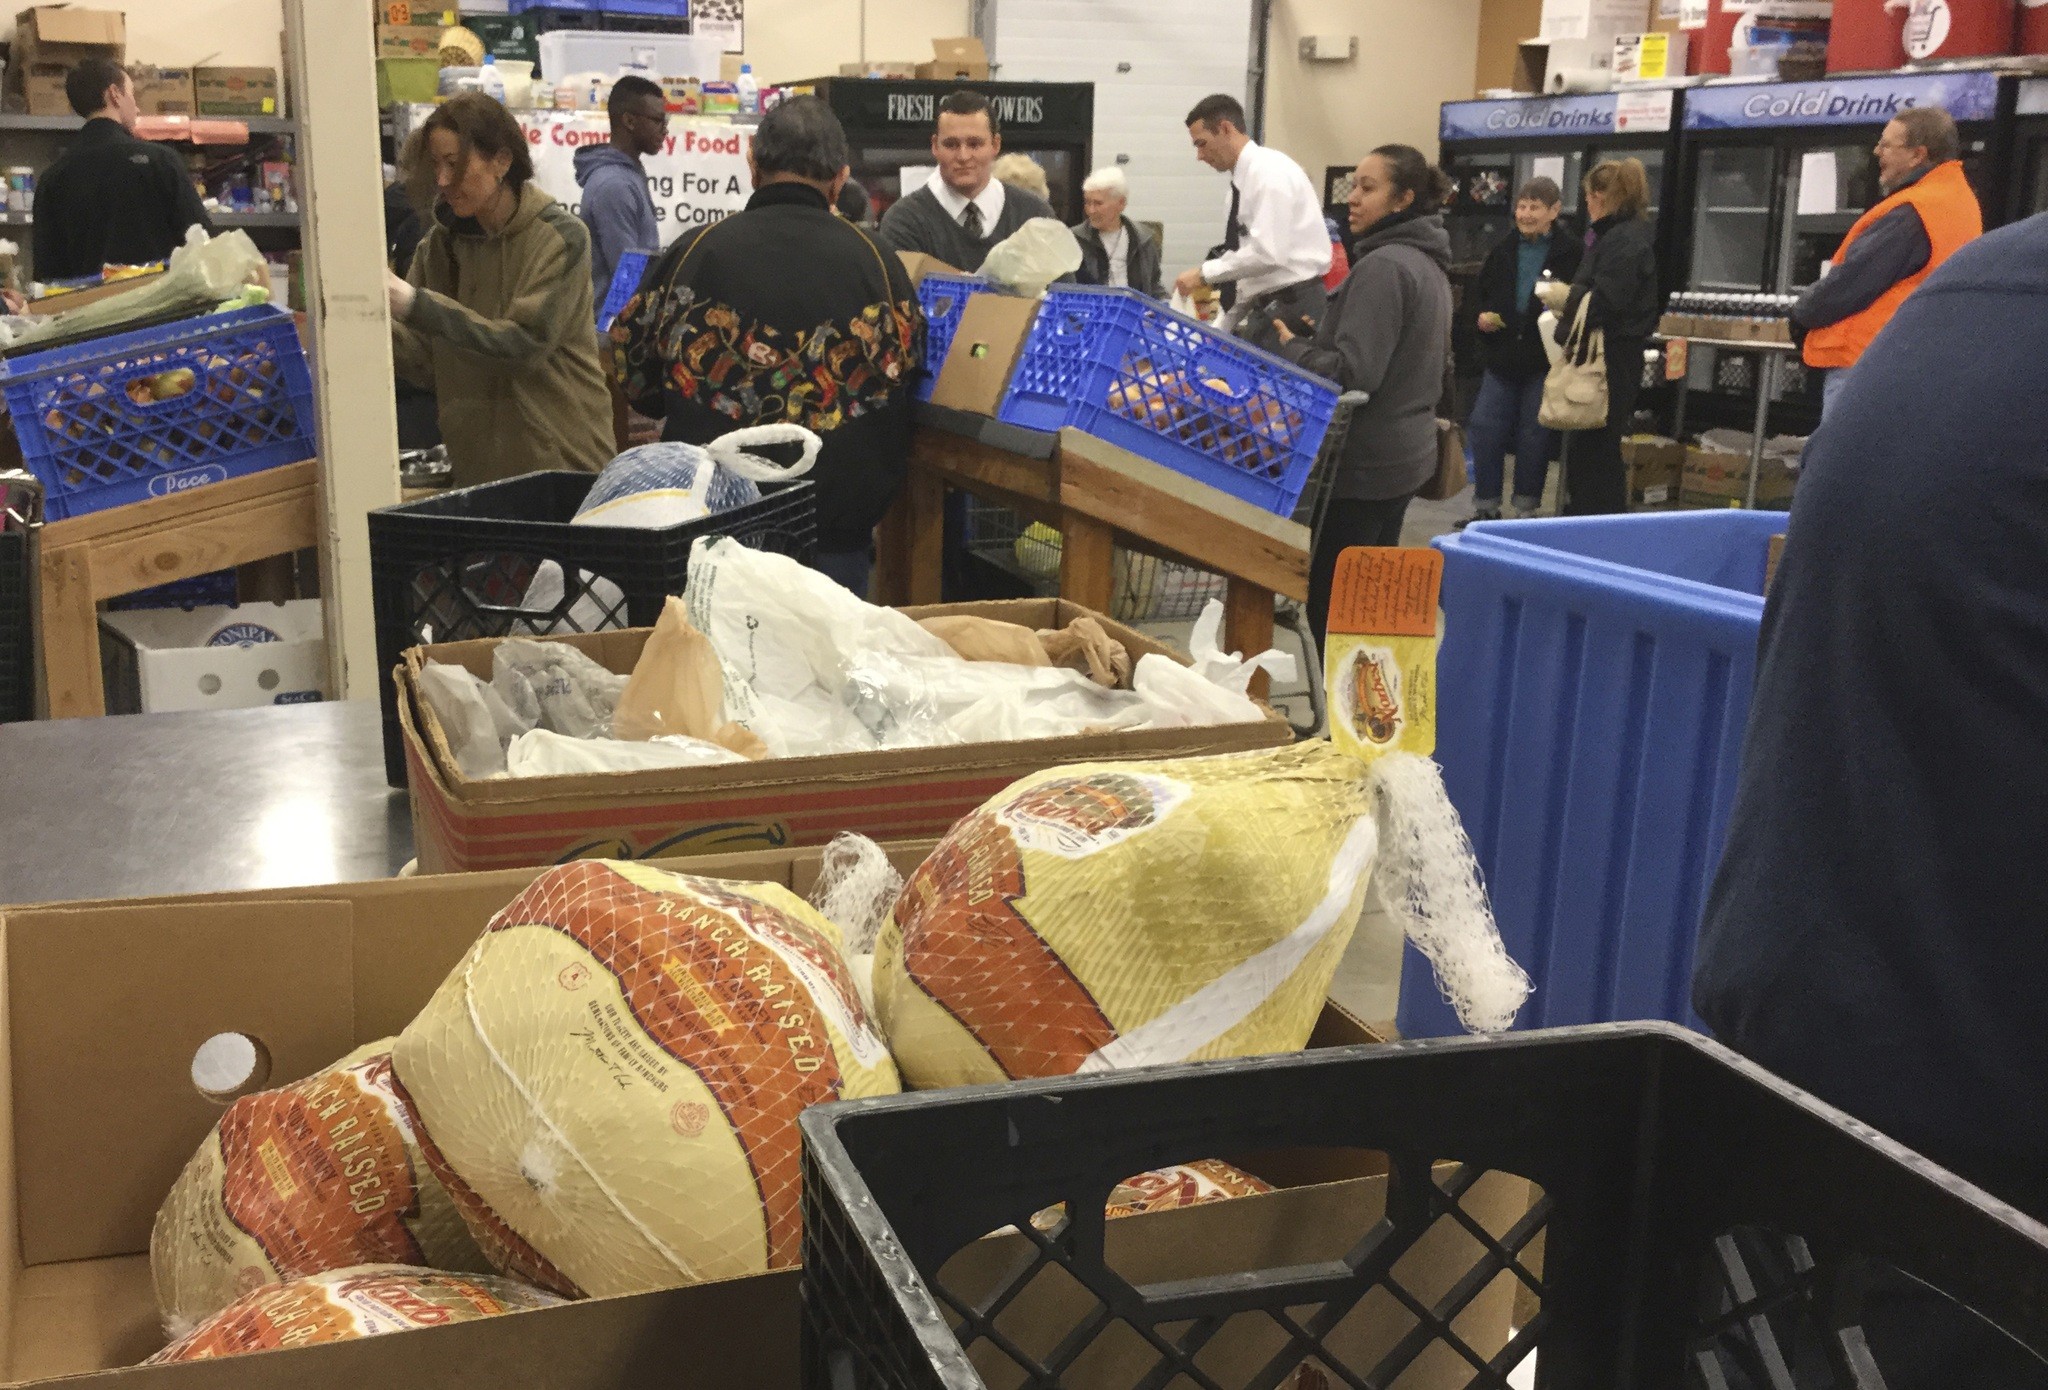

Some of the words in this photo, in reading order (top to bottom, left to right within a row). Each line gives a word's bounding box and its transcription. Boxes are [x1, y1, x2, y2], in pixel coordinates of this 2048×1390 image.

[887, 93, 935, 122] FRESH
[985, 95, 1044, 123] OWERS
[1742, 89, 1829, 118] Cold
[1827, 92, 1917, 117] Drinks
[1486, 106, 1549, 131] Cold
[1549, 108, 1615, 129] Drinks
[685, 131, 741, 156] Food
[683, 173, 720, 194] For
[725, 175, 741, 195] A
[166, 473, 212, 494] Pace
[655, 900, 750, 959] RANCH
[745, 963, 823, 1073] RAISED
[727, 970, 771, 1027] TURKEY
[657, 1065, 669, 1077] BY
[329, 1116, 388, 1214] RAISED
